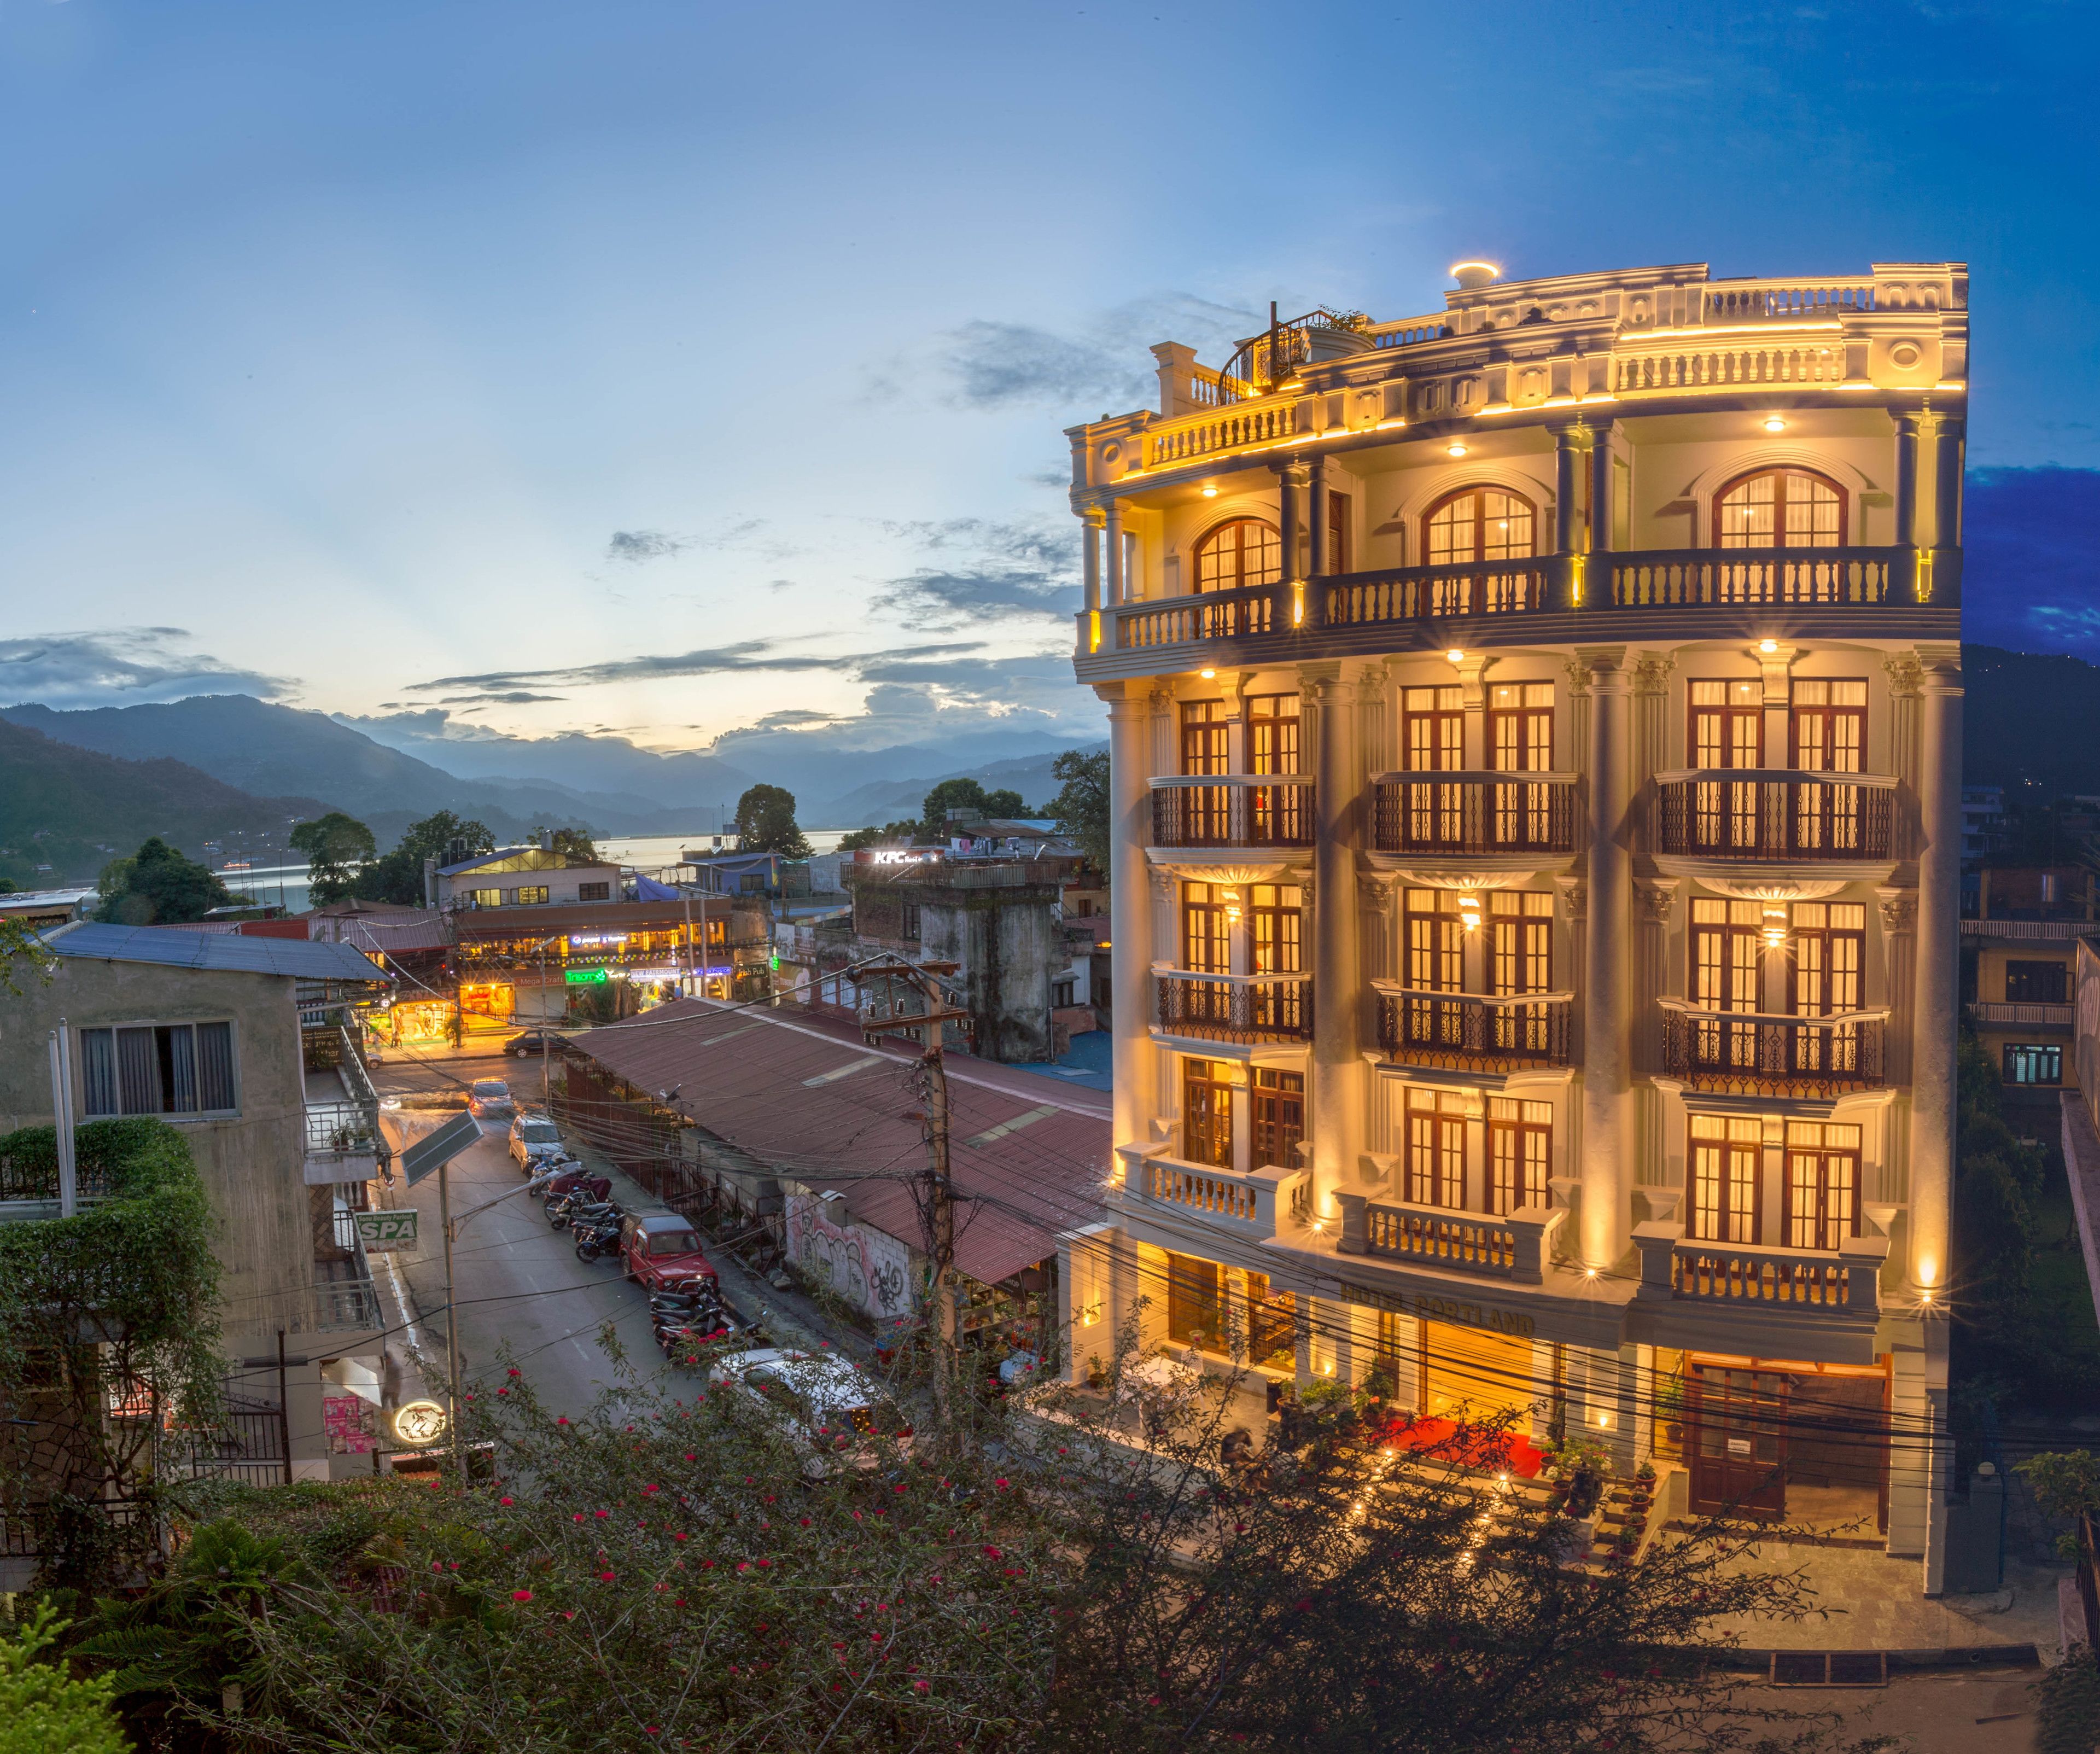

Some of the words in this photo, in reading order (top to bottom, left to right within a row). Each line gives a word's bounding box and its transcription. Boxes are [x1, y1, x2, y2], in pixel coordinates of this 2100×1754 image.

[874, 851, 907, 864] KFC
[738, 969, 751, 978] Irish
[361, 1220, 416, 1240] SPA
[1340, 1284, 1408, 1314] HOTEL
[1415, 1295, 1535, 1337] PORTLAND
